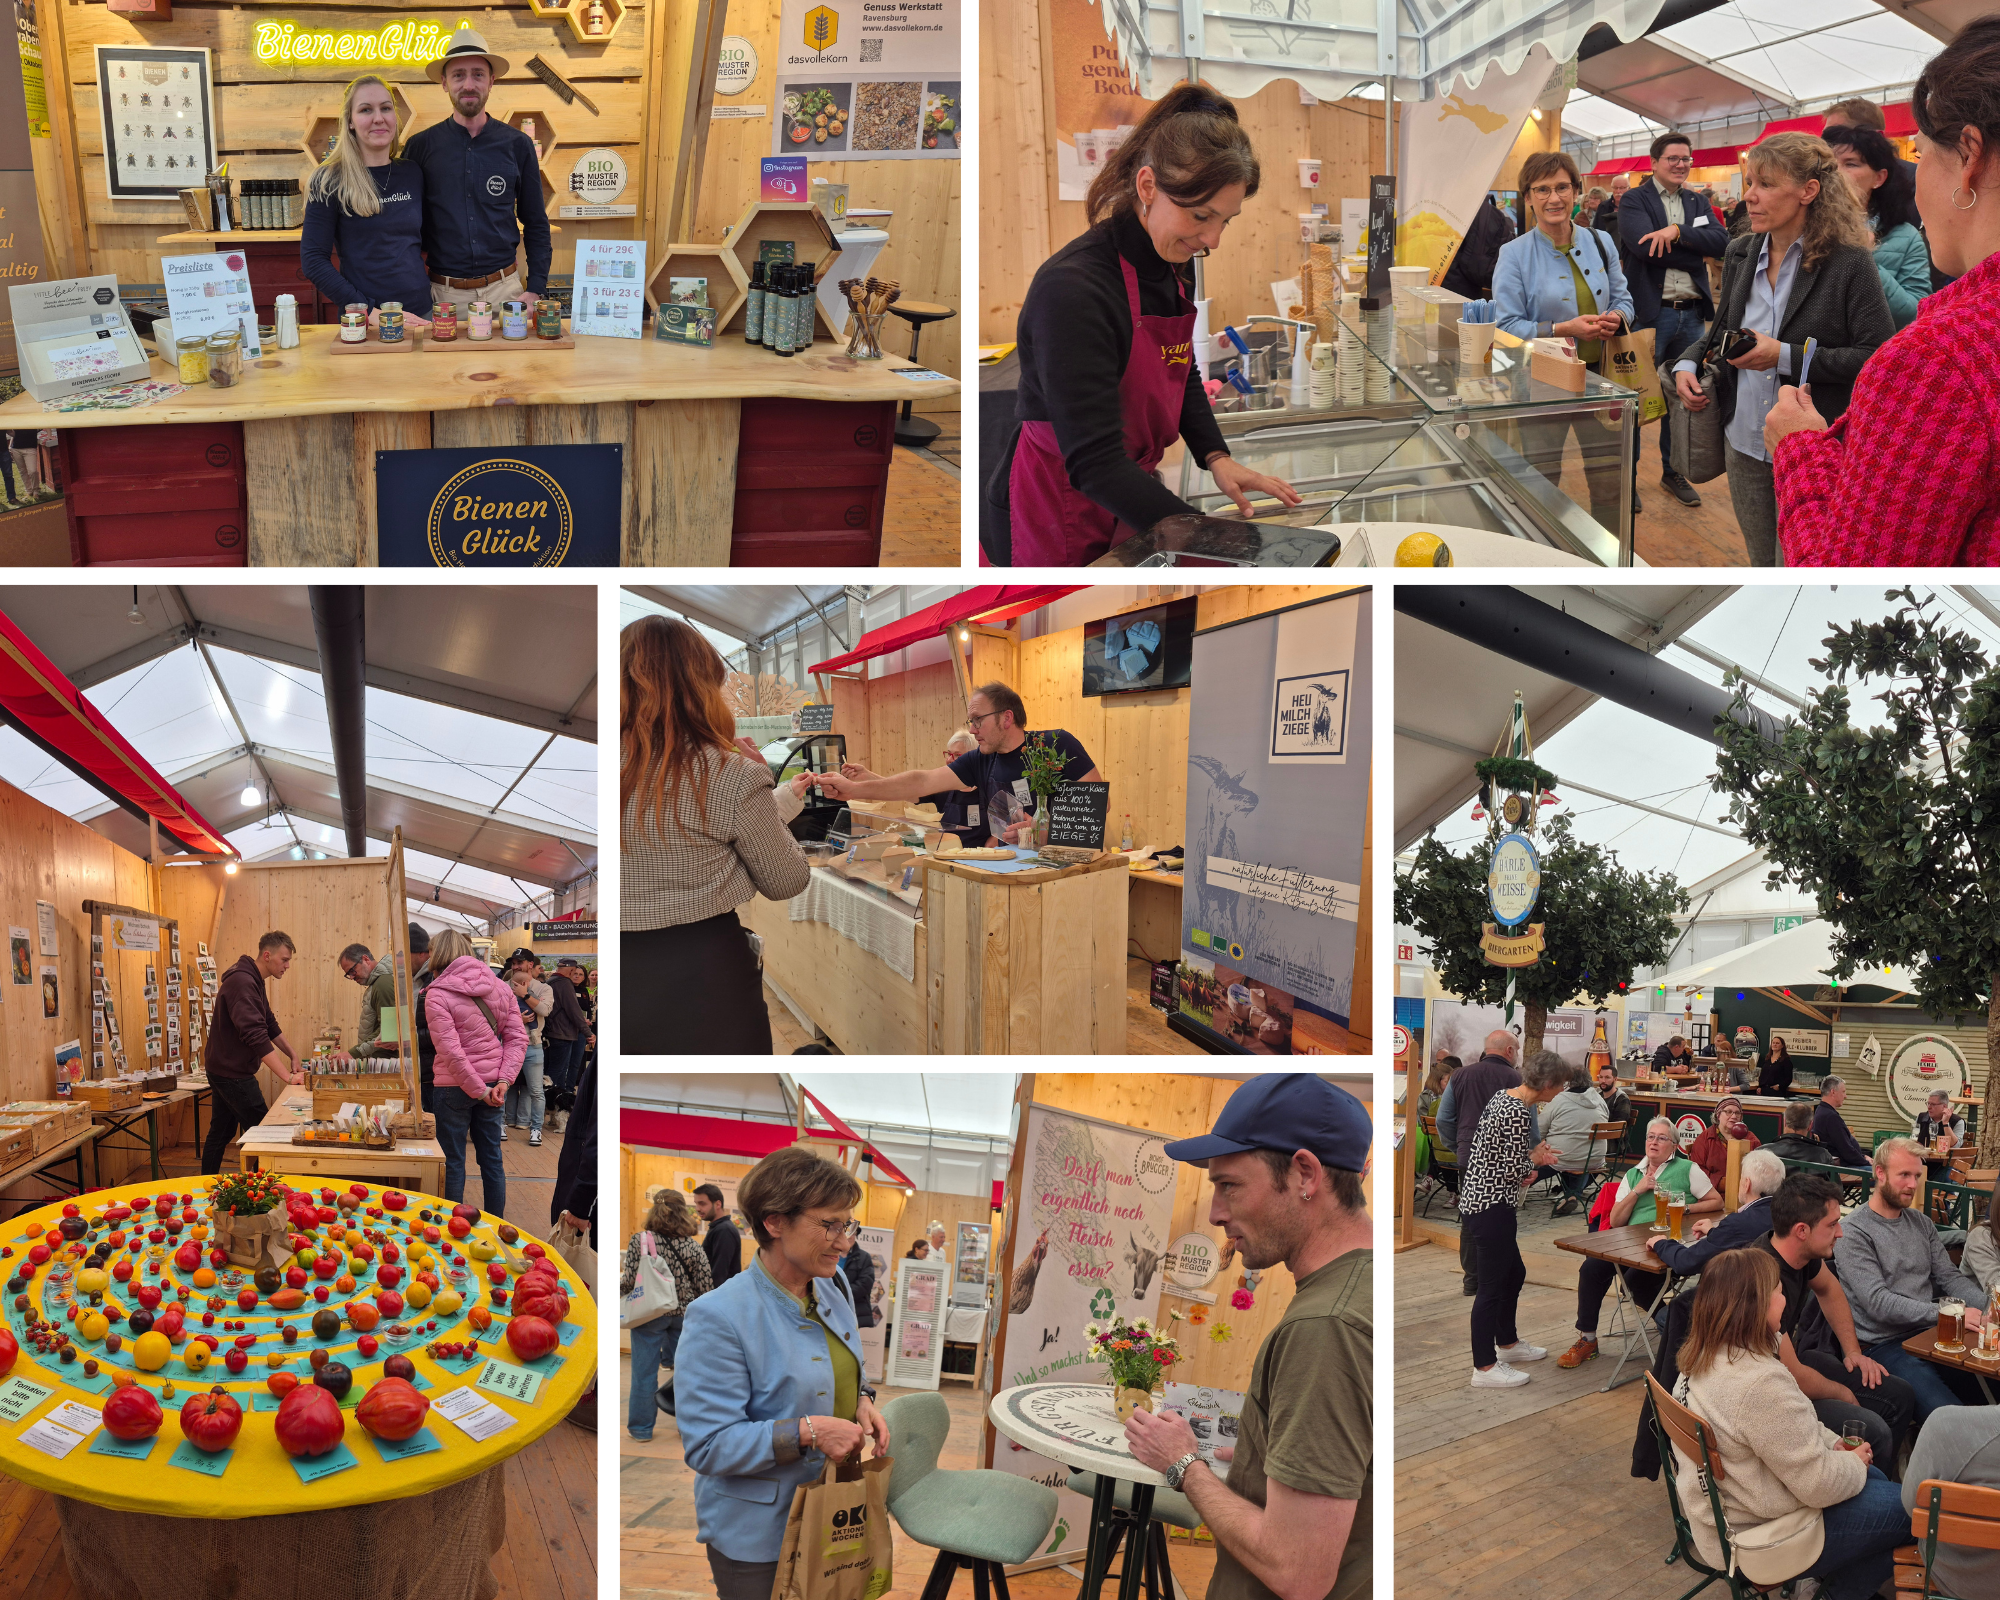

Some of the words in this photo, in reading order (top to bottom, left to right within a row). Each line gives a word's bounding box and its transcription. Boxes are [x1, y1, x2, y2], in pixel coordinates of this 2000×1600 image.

[863, 2, 897, 11] Genuss
[899, 2, 943, 11] Werkstatt
[863, 14, 908, 22] Ravensburg
[256, 20, 470, 61] BienenGlüc
[719, 49, 745, 61] BIO
[787, 54, 848, 64] dasvolleKorn
[144, 67, 166, 75] BIENEN
[587, 160, 614, 172] BIO
[1371, 209, 1385, 235] Kugel
[590, 244, 596, 253] 4
[598, 244, 614, 254] für
[615, 245, 634, 254] 29€
[168, 261, 214, 274] Preisliste
[593, 287, 599, 296] 3
[601, 287, 617, 297] für
[618, 288, 631, 297] 23
[633, 289, 640, 298] €
[453, 495, 548, 521] Bienen
[462, 525, 541, 555] Glück
[1292, 693, 1312, 707] HEU
[1280, 708, 1311, 722] MILCH
[1282, 722, 1310, 736] ZIEGE
[1089, 784, 1106, 793] Käse
[1071, 796, 1083, 804] 100
[1051, 830, 1086, 841] ZIEGE
[1499, 857, 1526, 872] HÄRLE
[1232, 861, 1279, 883] natürliche
[1278, 865, 1339, 907] Fütterung
[1497, 883, 1527, 896] WEISSE
[1247, 882, 1279, 903] hofeigene
[1487, 942, 1535, 956] BIERGARTEN
[1063, 1155, 1102, 1188] Darf
[1106, 1170, 1135, 1187] man
[1041, 1188, 1110, 1216] eigentlich
[1113, 1203, 1146, 1221] noch
[1068, 1222, 1115, 1248] Fleisch
[1182, 1243, 1208, 1258] BIO
[1179, 1262, 1209, 1274] REGION
[1180, 1255, 1212, 1268] MUSTER
[1068, 1261, 1114, 1279] essen?
[915, 1274, 936, 1283] GRAD
[910, 1322, 931, 1331] GRAD
[1040, 1326, 1060, 1351] Ja!
[478, 1362, 498, 1385] Tomaten
[1014, 1367, 1038, 1386] Und
[1040, 1364, 1049, 1377] so
[1052, 1351, 1083, 1372] machst
[494, 1371, 507, 1385] bitte
[507, 1374, 519, 1389] nicht
[14, 1380, 47, 1396] Tomaten
[515, 1373, 533, 1399] berühren
[11, 1389, 30, 1401] bitte
[2, 1397, 24, 1408] nicht
[831, 1531, 865, 1543] WOCHEN
[832, 1526, 865, 1537] AKTIONS
[824, 1569, 836, 1578] Wir
[835, 1562, 853, 1573] sind
